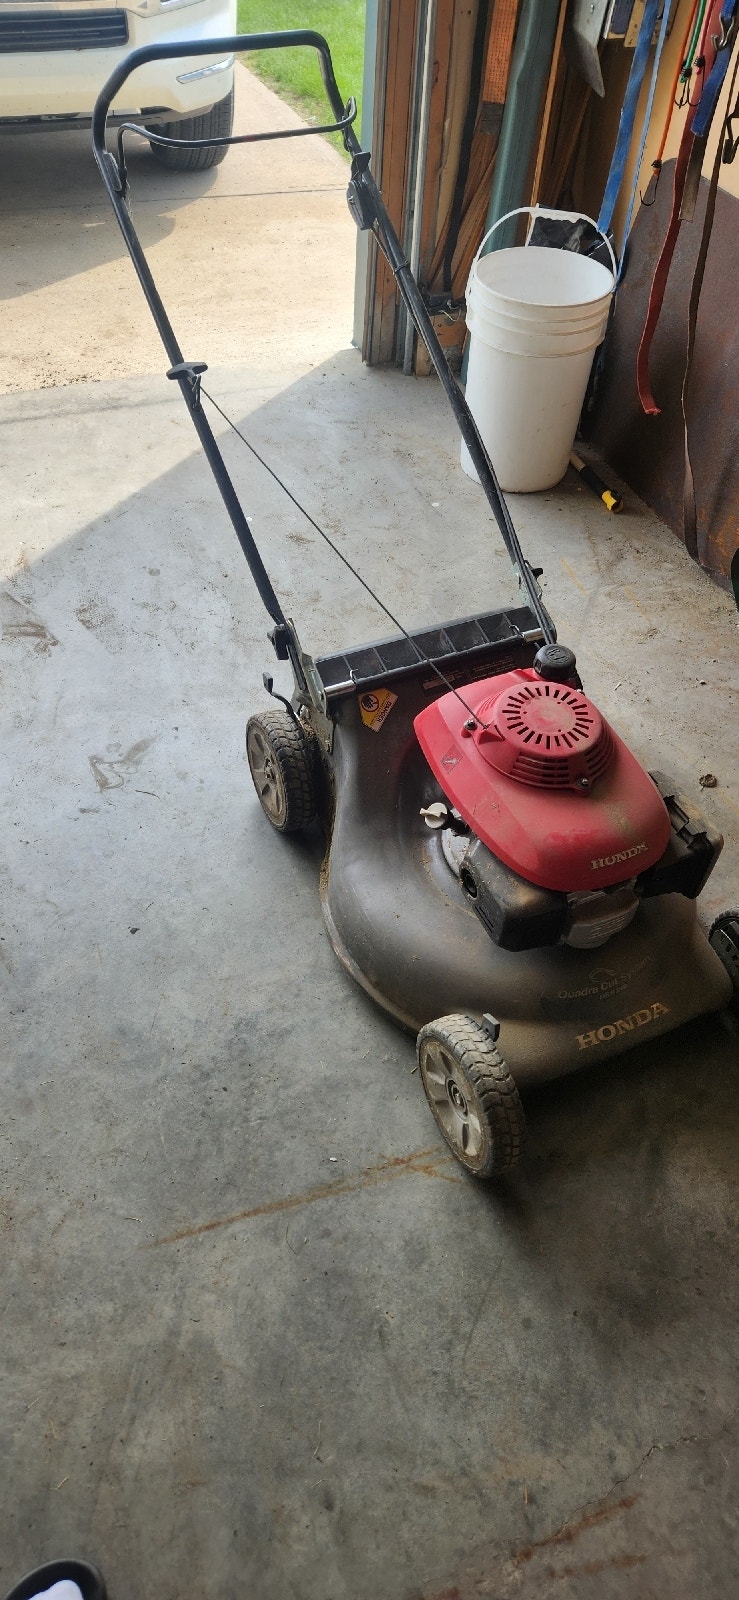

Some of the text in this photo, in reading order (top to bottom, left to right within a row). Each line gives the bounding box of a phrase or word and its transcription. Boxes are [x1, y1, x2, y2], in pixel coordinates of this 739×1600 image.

[377, 701, 392, 722] DANGER
[590, 842, 649, 870] HONDA
[558, 985, 599, 999] Quadra
[600, 977, 619, 991] Cut
[575, 1002, 671, 1051] HONDA
